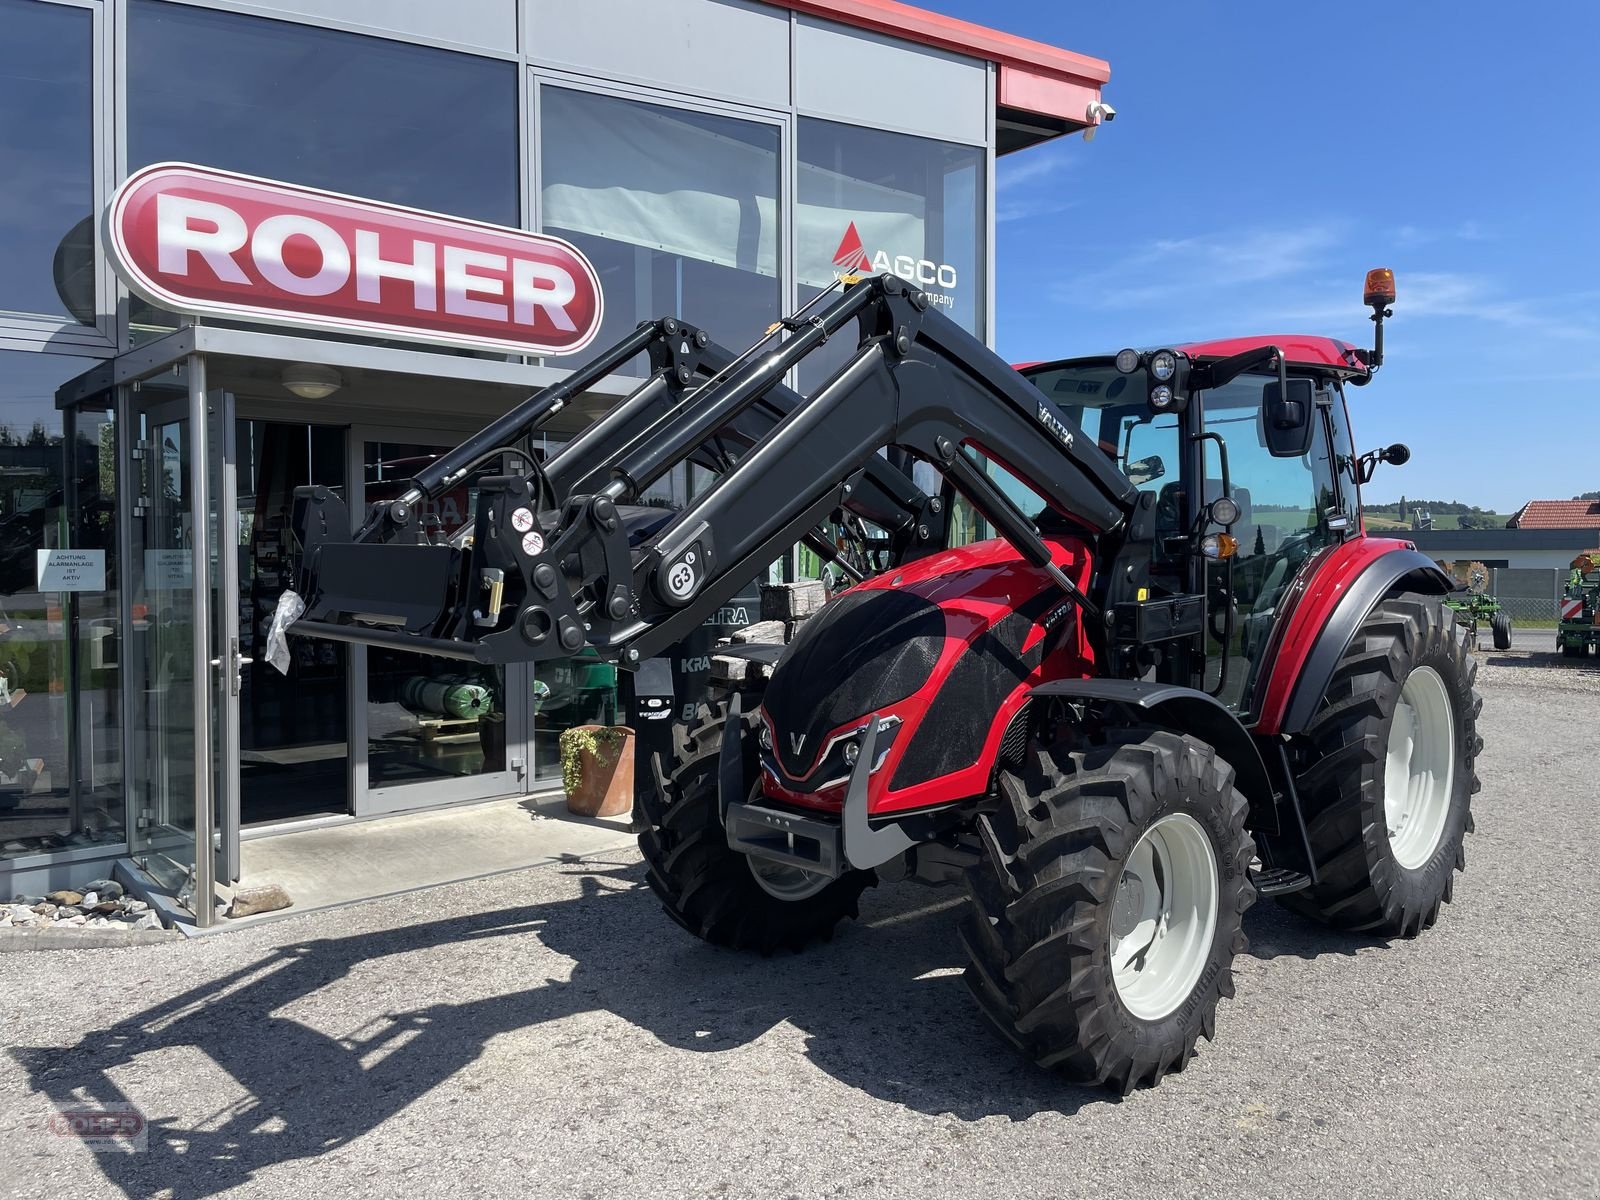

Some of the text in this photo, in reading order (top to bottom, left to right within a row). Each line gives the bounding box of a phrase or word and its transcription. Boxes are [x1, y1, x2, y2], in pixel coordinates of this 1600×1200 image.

[155, 192, 580, 333] ROHER
[872, 250, 957, 289] AGCO
[672, 567, 691, 591] G3
